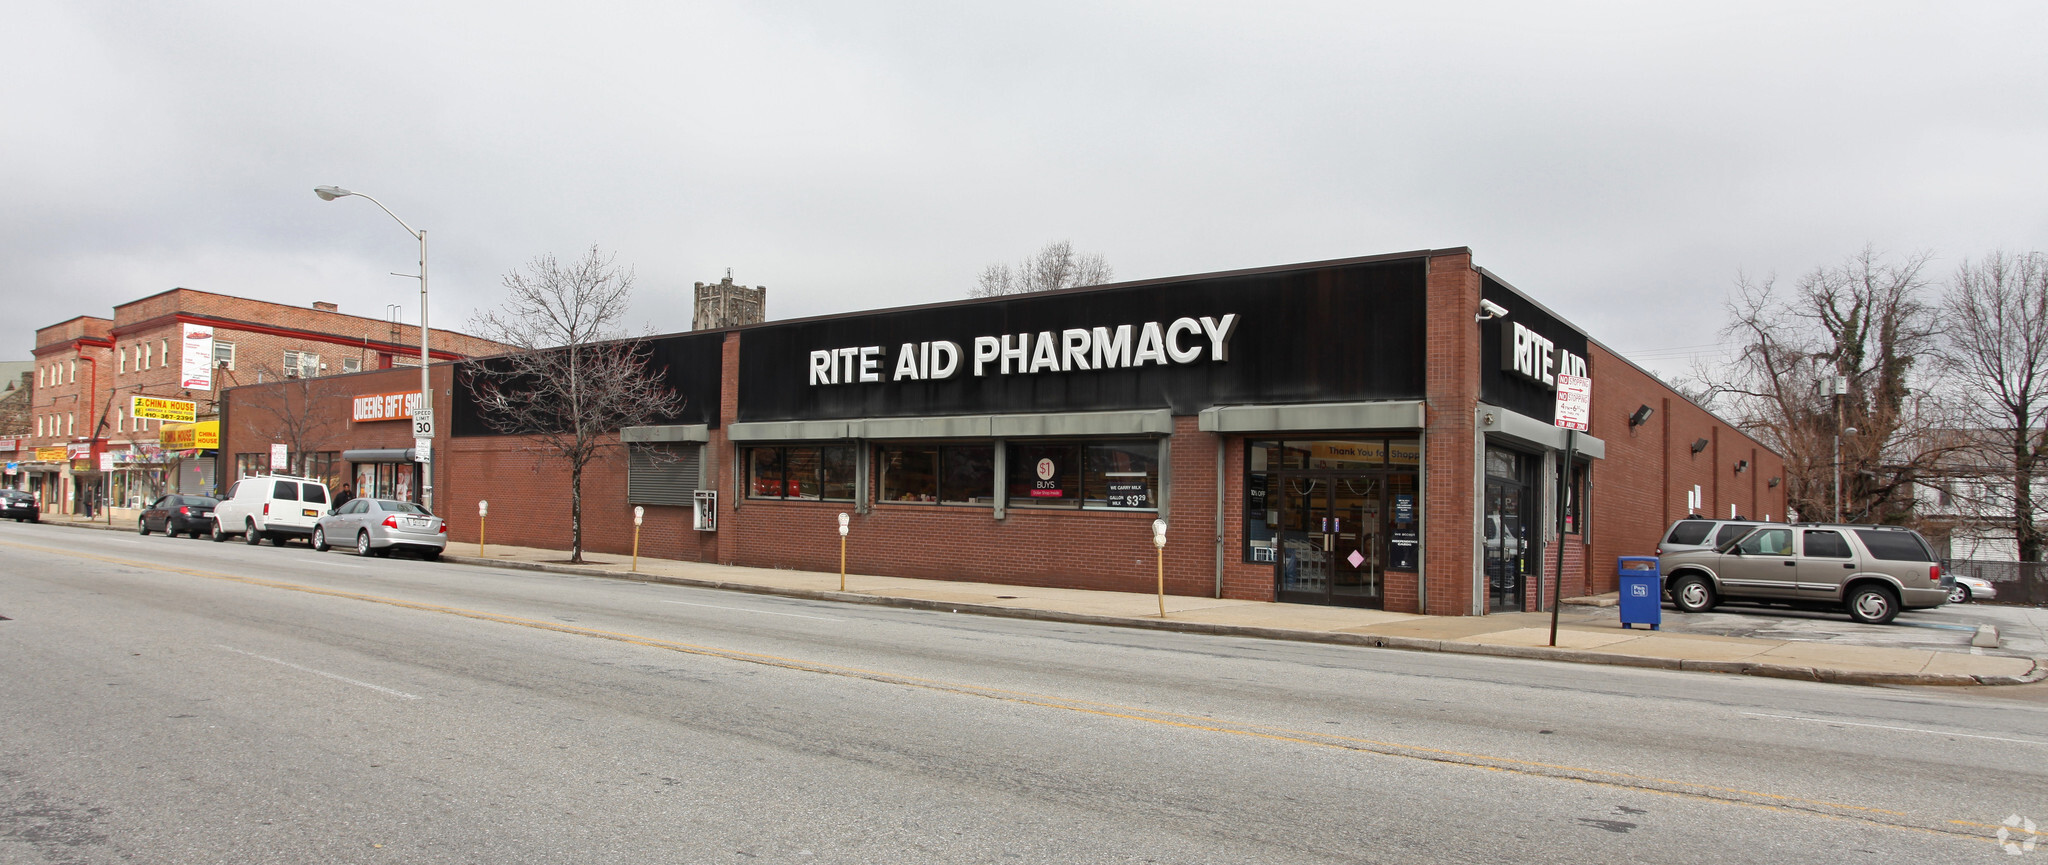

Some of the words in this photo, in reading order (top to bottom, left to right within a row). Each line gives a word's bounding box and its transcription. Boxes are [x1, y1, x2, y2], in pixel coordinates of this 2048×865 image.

[809, 345, 884, 386] RITE
[893, 340, 964, 382] AID
[973, 313, 1240, 377] PHARMACY
[1513, 321, 1554, 388] RITE
[1559, 376, 1568, 384] NO
[1569, 377, 1589, 388] STOPPING
[1558, 392, 1567, 401] NO
[1568, 393, 1588, 404] STOPPING
[145, 399, 167, 409] CHINA
[171, 402, 195, 412] HOUSE
[353, 394, 384, 421] QUEEN'S
[385, 394, 404, 418] GIFT
[405, 392, 422, 417] SHO
[416, 422, 431, 433] 30
[1329, 446, 1355, 456] Thank
[1357, 448, 1373, 457] You
[1375, 449, 1385, 457] fo
[1039, 462, 1050, 476] $1
[1036, 481, 1055, 489] BUYS
